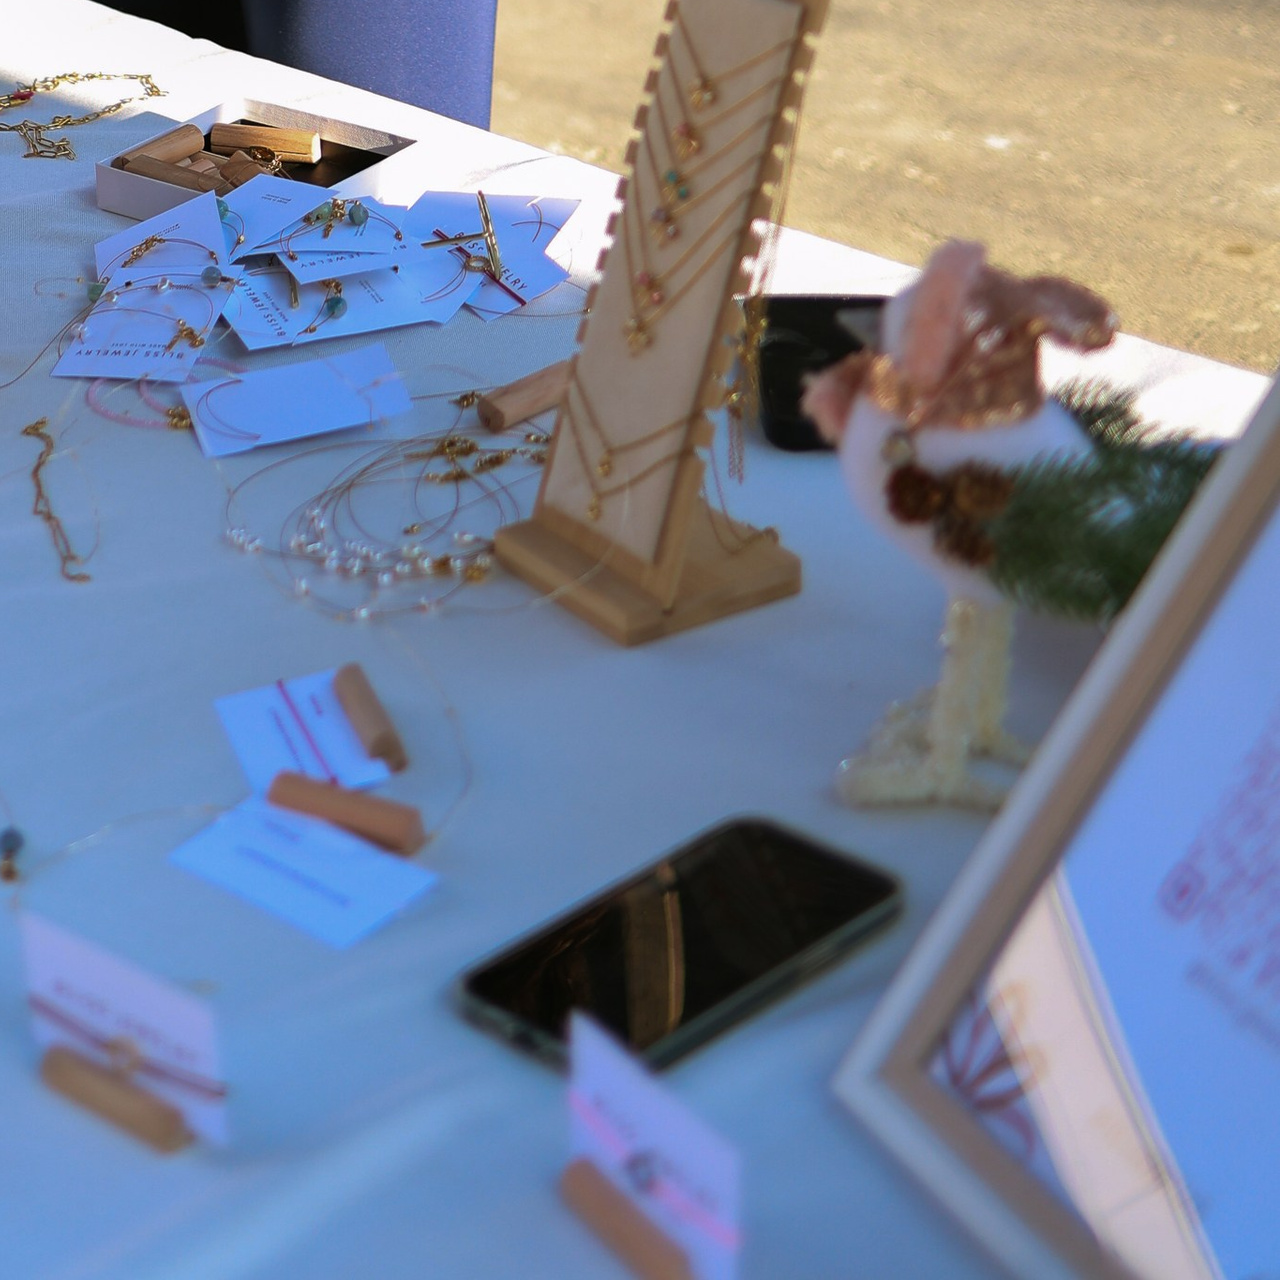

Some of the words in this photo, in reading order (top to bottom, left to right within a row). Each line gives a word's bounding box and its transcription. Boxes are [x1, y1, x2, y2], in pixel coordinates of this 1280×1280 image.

[263, 312, 287, 337] BLISS
[75, 348, 139, 359] JEWELRY
[143, 350, 185, 360] BLISS
